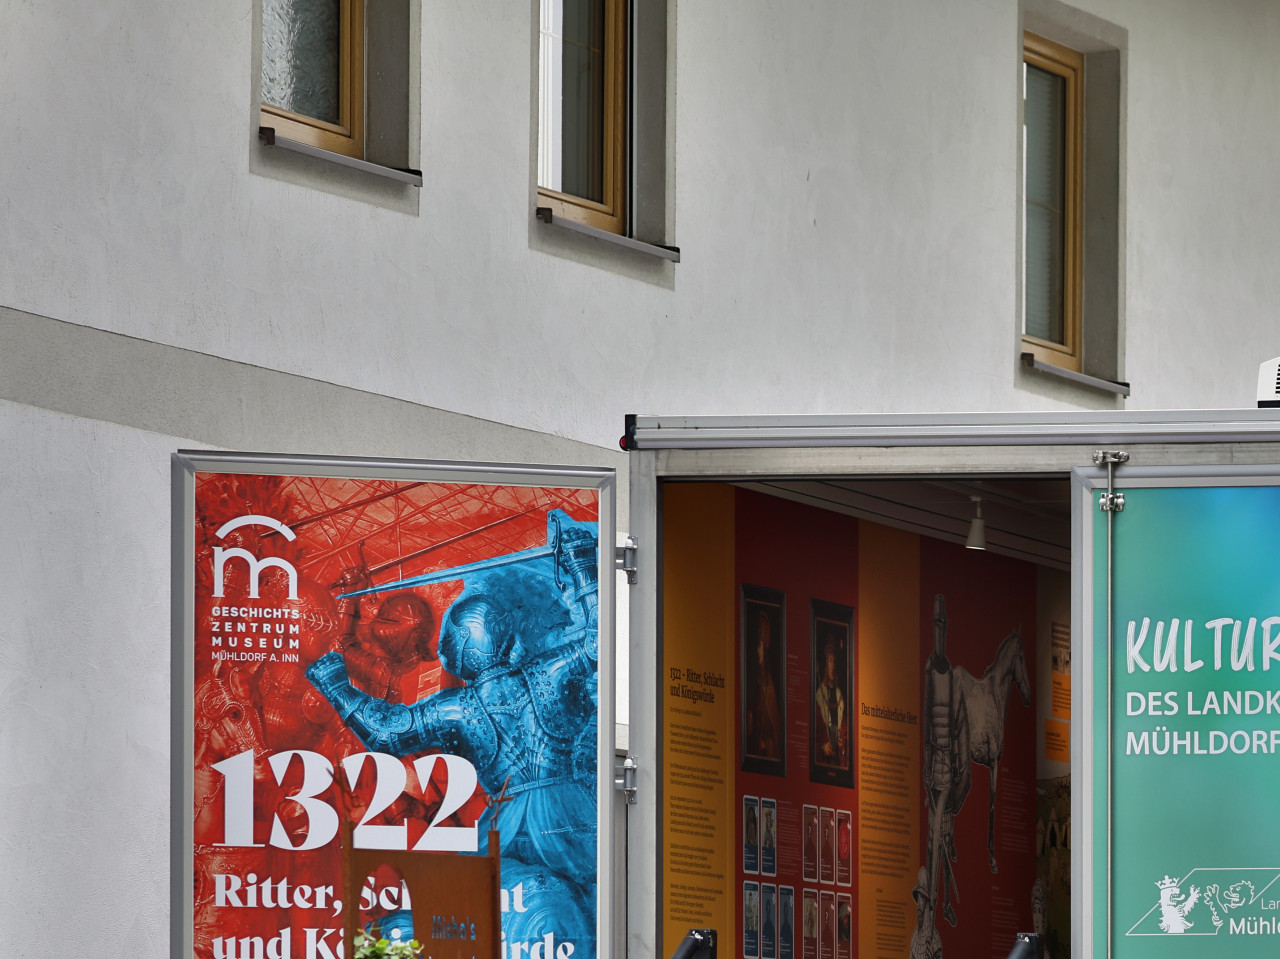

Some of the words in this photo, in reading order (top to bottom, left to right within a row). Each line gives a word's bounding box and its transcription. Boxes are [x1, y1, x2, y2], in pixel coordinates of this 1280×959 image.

[211, 606, 300, 619] GESCHICHTS
[211, 621, 299, 634] ZENTRUM
[211, 636, 299, 649] MUSEUM
[211, 650, 267, 662] MÜHLDORF
[269, 653, 279, 662] A.
[281, 653, 299, 663] INN
[670, 667, 681, 682] 1322
[686, 668, 703, 687] Ritter,
[703, 670, 725, 688] Schlacht
[670, 684, 680, 698] und
[861, 703, 870, 716] Das
[1126, 691, 1179, 716] DES
[211, 749, 478, 852] 1322
[212, 872, 343, 917] Ritter,
[431, 915, 476, 941] Micha's
